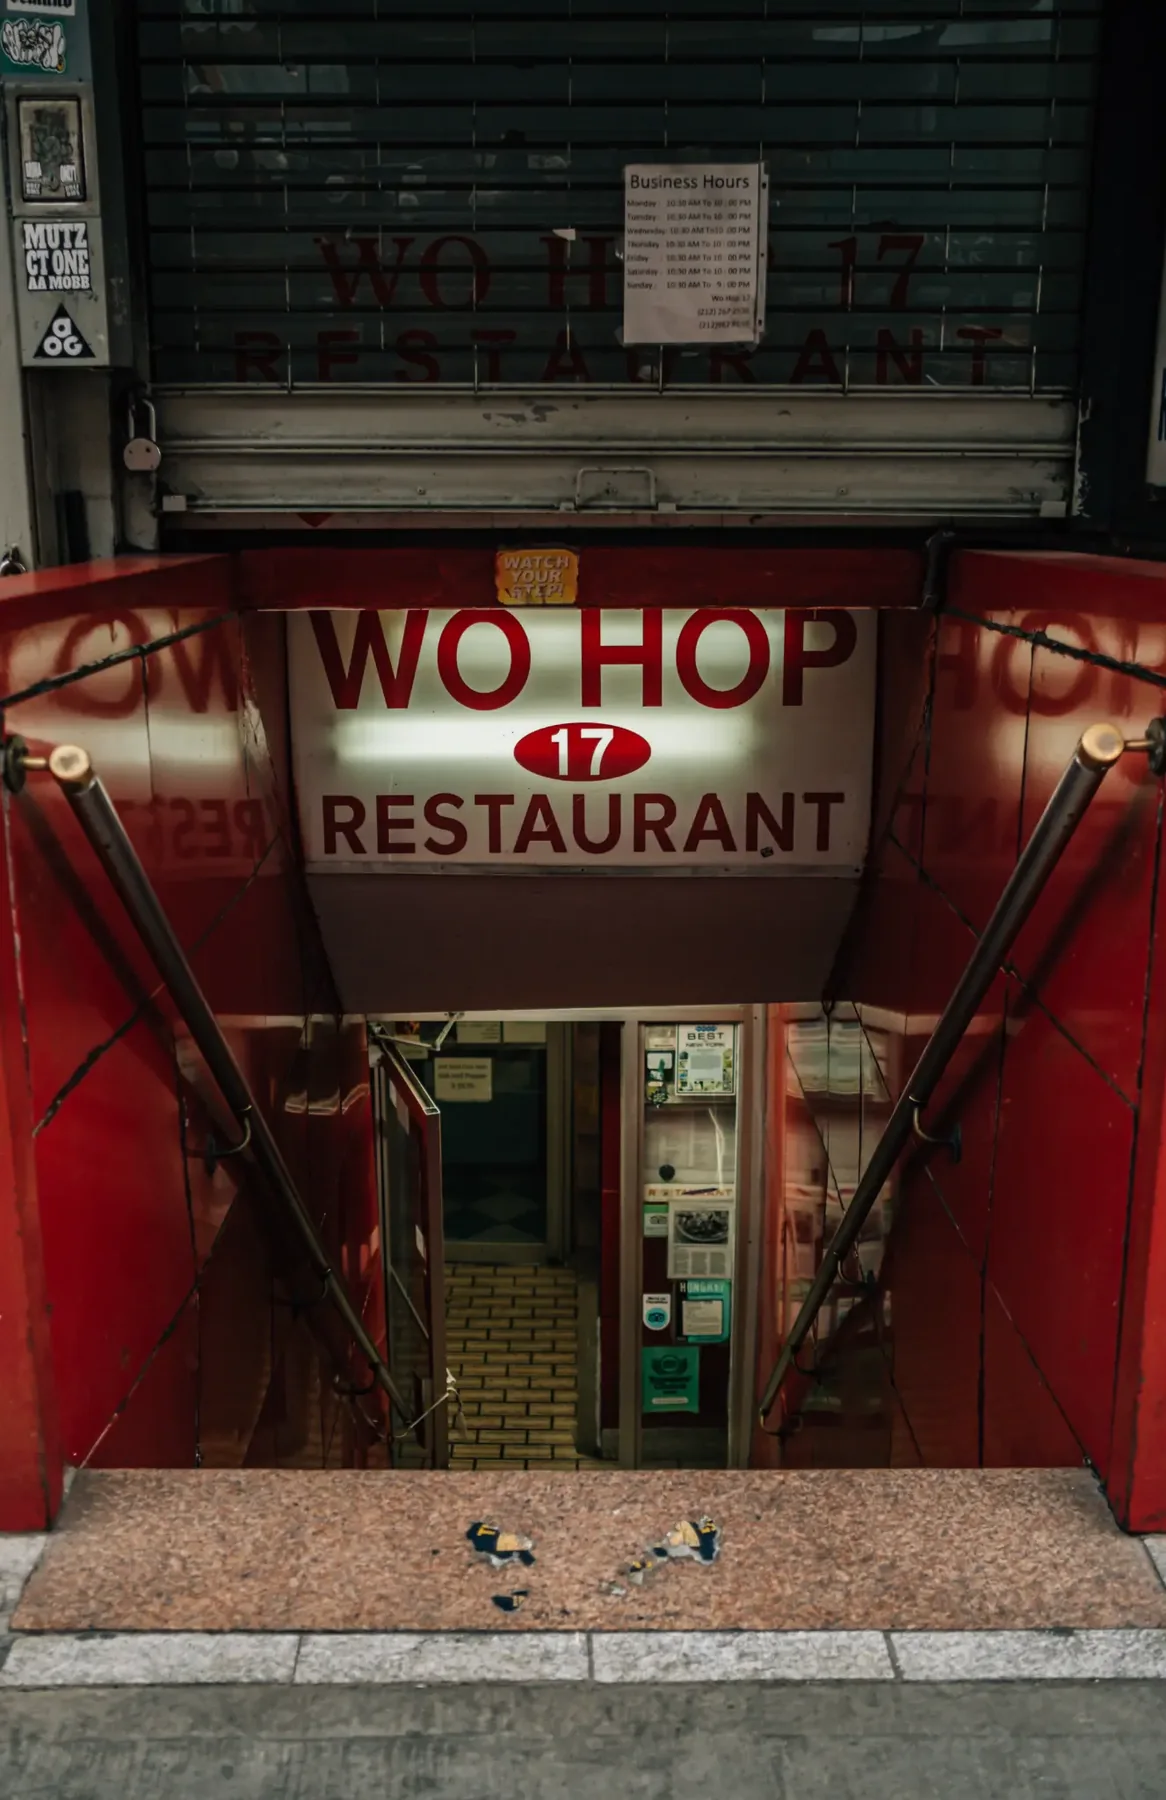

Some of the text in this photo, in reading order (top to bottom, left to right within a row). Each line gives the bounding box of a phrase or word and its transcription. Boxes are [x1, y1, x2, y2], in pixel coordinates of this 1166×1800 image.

[630, 174, 749, 189] Business Hours
[688, 199, 701, 207] AM
[702, 199, 712, 207] To
[739, 199, 751, 207] PM
[688, 212, 701, 221] AM
[702, 212, 712, 221] To
[738, 212, 751, 221] PM
[23, 223, 87, 249] MUTZ
[691, 226, 704, 234] AM
[738, 226, 751, 234] PM
[687, 240, 700, 248] AM
[701, 240, 711, 248] To
[737, 240, 751, 248] PM
[26, 250, 89, 275] CT ONE
[313, 235, 491, 311] WO
[828, 235, 924, 311] 17
[28, 276, 90, 290] AA MOBB
[688, 281, 701, 289] AM
[702, 281, 712, 289] To
[716, 281, 722, 289] 9
[738, 281, 750, 289] PM
[503, 555, 570, 569] WATCH
[511, 569, 563, 583] YOUR
[308, 609, 858, 711] WO HOP
[550, 728, 615, 776] 17
[321, 792, 846, 855] RESTAURANT
[687, 1032, 724, 1040] BEST
